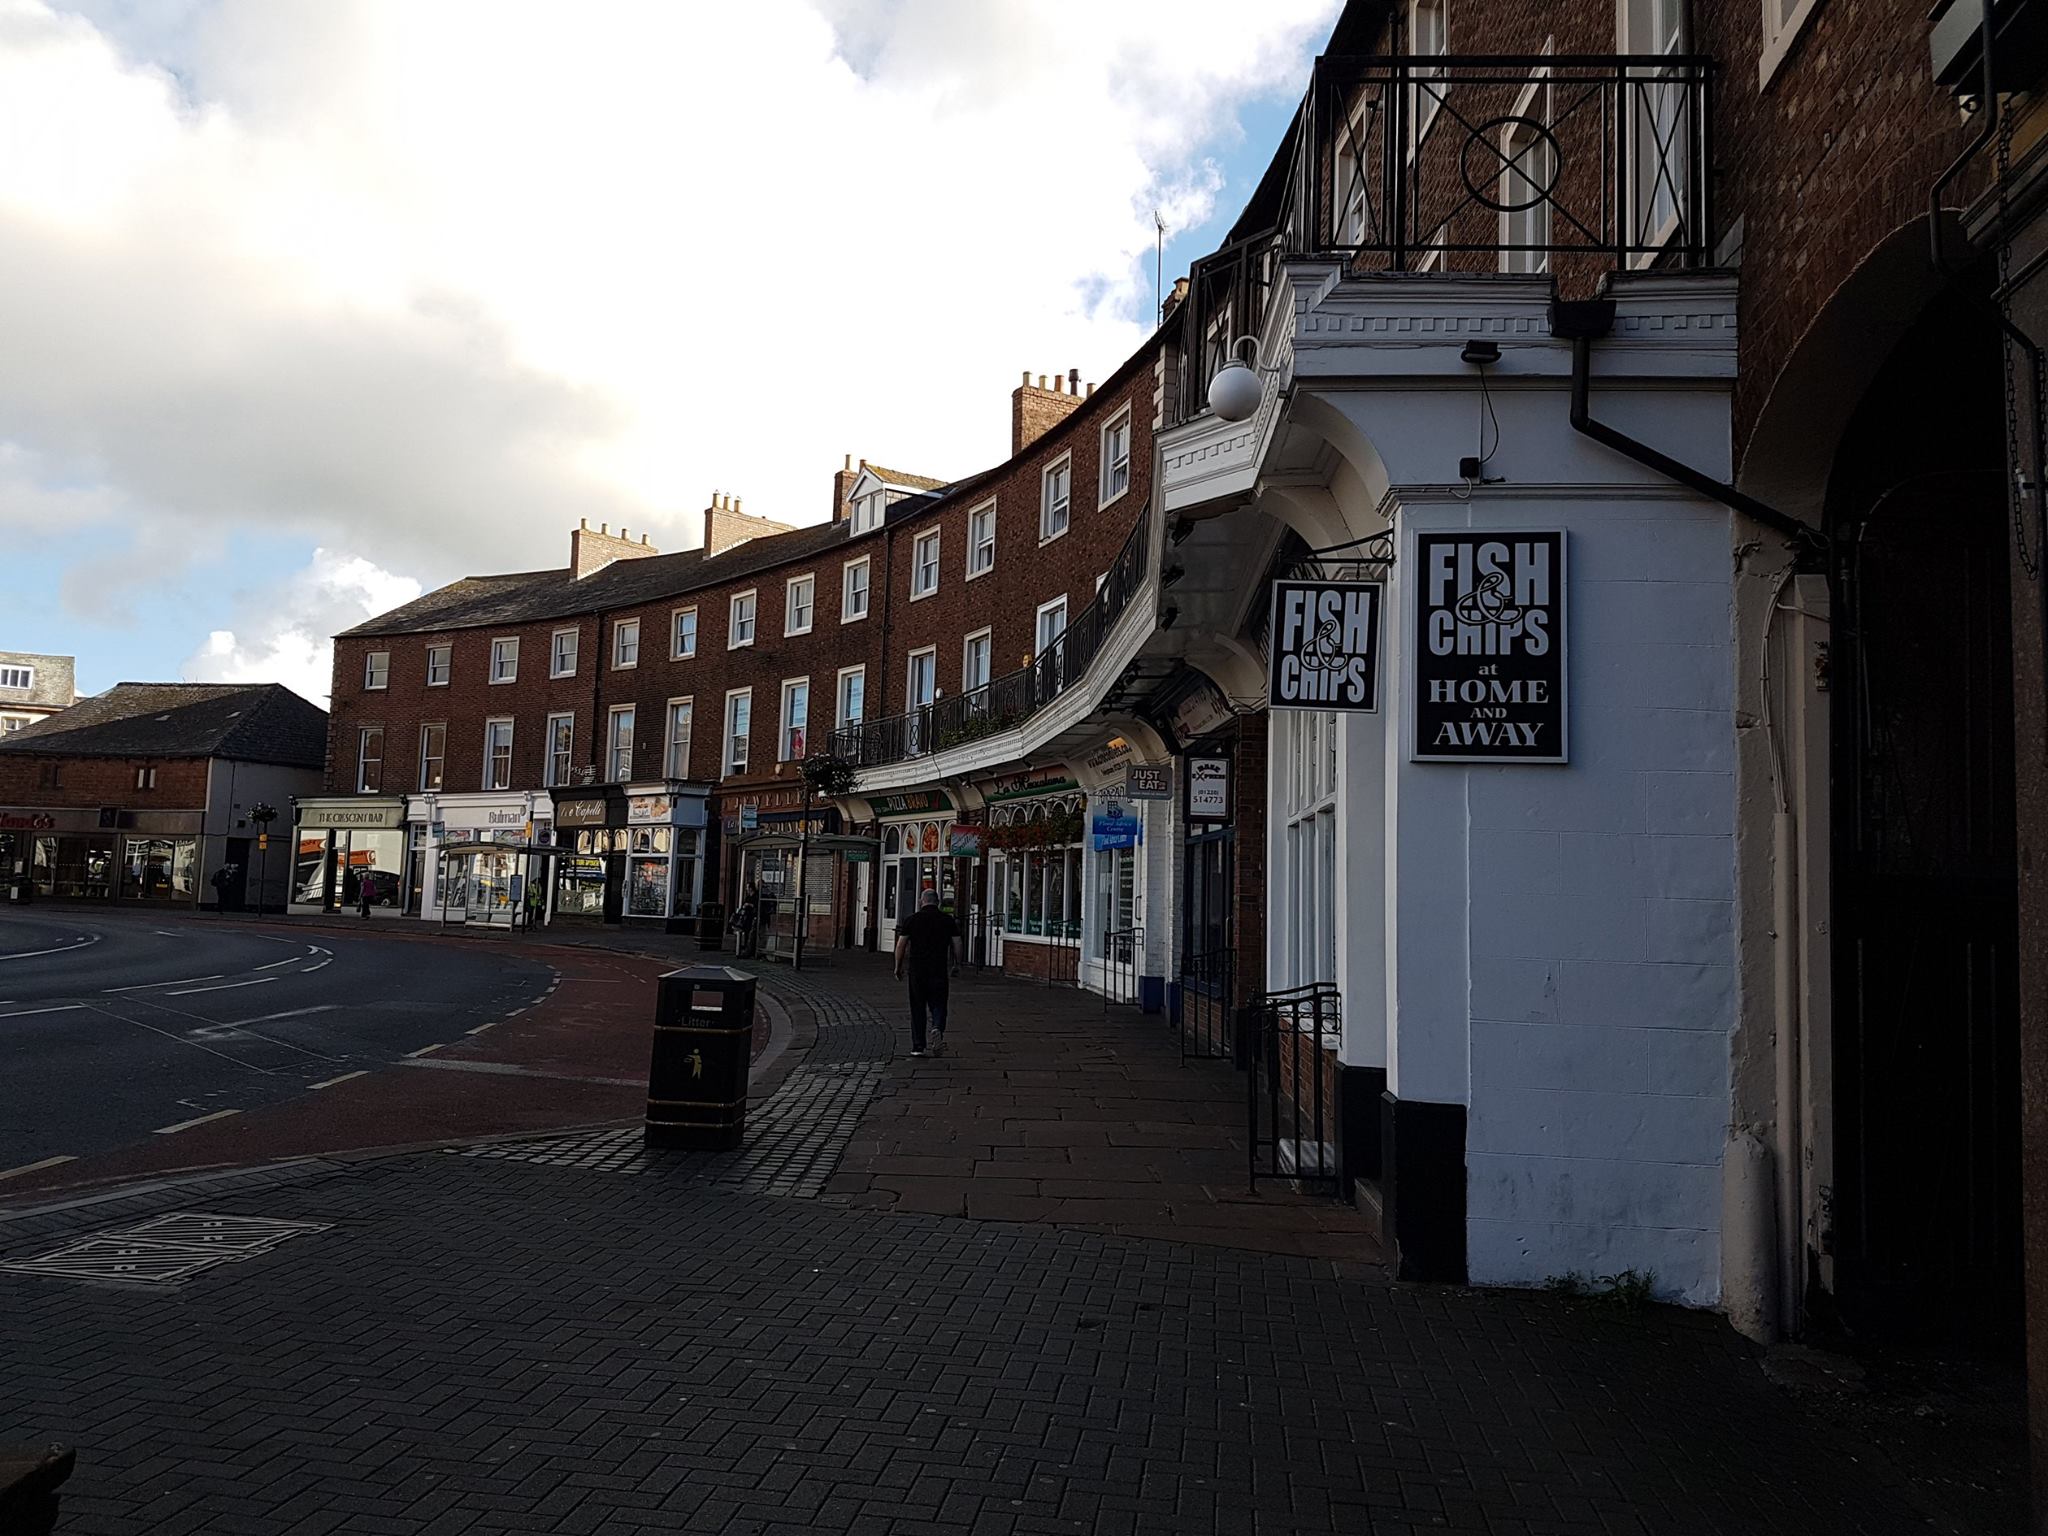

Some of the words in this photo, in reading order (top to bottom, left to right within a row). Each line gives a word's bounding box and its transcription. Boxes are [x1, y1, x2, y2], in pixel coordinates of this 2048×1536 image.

[1428, 542, 1550, 607] FISH
[1455, 572, 1523, 625] &
[1282, 589, 1371, 655] FISH
[1428, 608, 1550, 657] CHIPS
[1300, 619, 1349, 671] &
[1279, 653, 1367, 704] CHIPS
[1478, 663, 1500, 676] at
[1428, 679, 1550, 704] HOME
[1469, 706, 1508, 719] AND
[1432, 721, 1545, 747] AWAY
[1132, 769, 1161, 781] JUST
[1138, 780, 1160, 790] EAT
[886, 795, 909, 812] PIZZA
[1192, 795, 1224, 804] 514773
